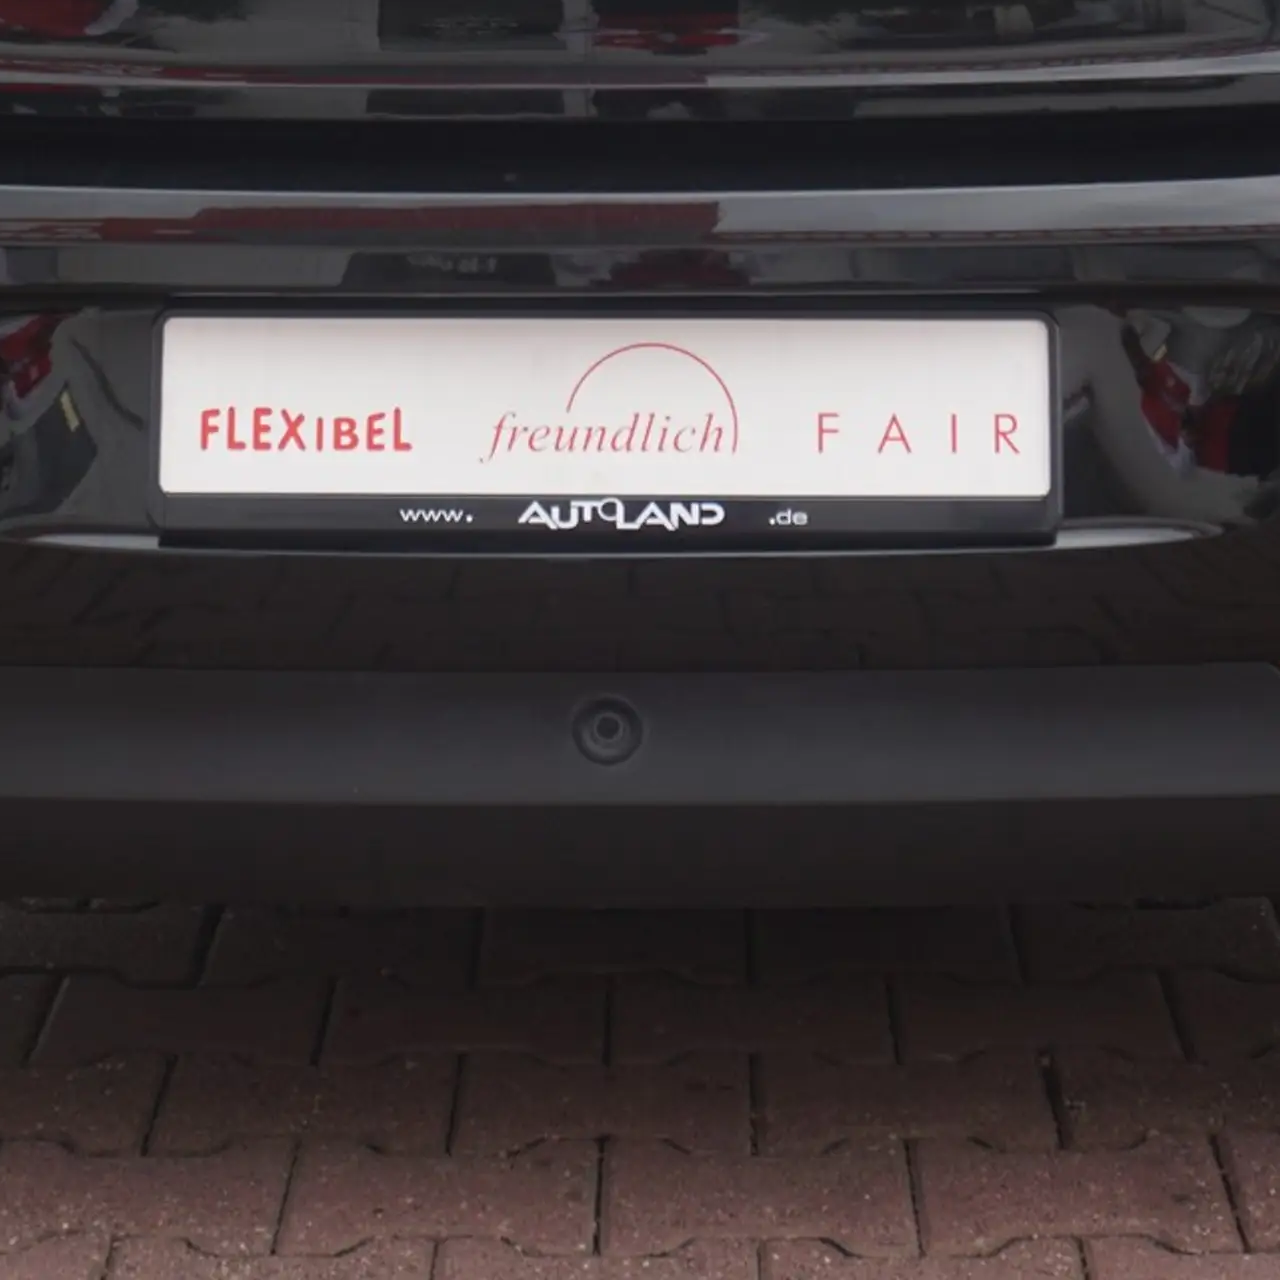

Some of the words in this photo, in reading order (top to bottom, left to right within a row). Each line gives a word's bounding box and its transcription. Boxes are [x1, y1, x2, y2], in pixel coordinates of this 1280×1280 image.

[199, 406, 413, 453] FLEXIBEL
[479, 412, 724, 463] freundlich
[399, 508, 474, 525] www.
[518, 497, 726, 532] AUTOLAND
[768, 506, 809, 526] .de
